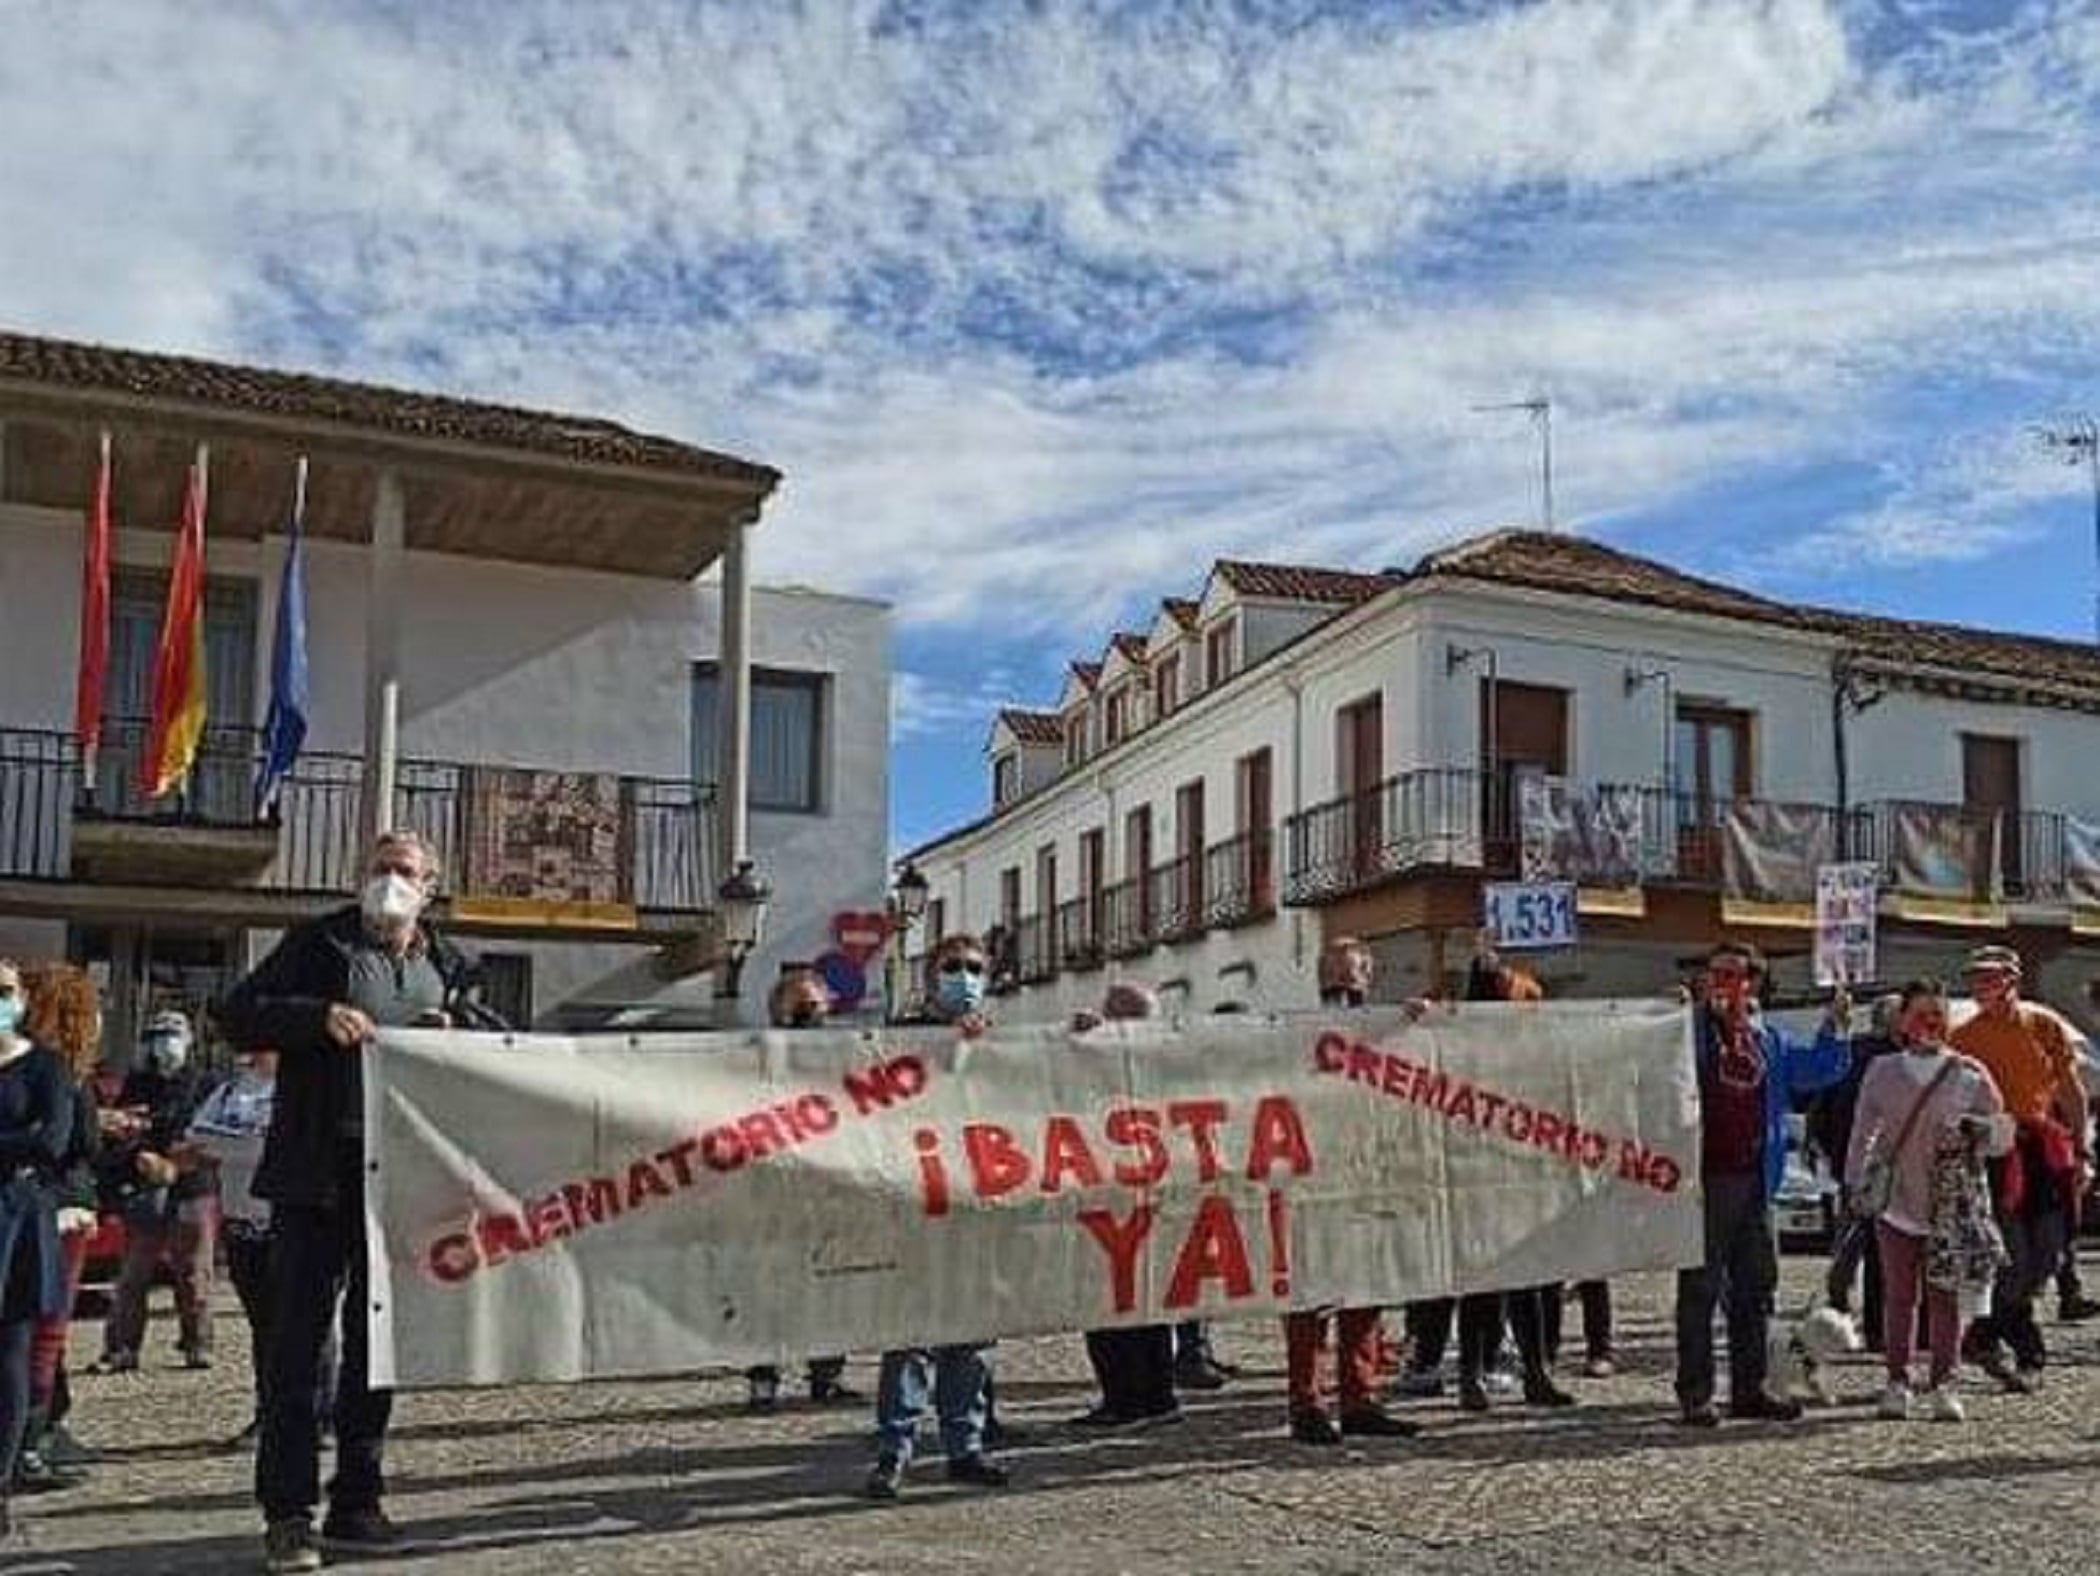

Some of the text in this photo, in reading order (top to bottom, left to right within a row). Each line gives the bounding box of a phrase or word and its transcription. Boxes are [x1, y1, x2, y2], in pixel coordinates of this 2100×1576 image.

[1491, 894, 1571, 939] 1.531
[429, 1054, 926, 1282] CREMATORIO NO
[914, 1095, 1313, 1217] ¡BASTA
[1314, 1031, 1681, 1193] CREMATORIO NO
[1076, 1189, 1290, 1313] YA!
